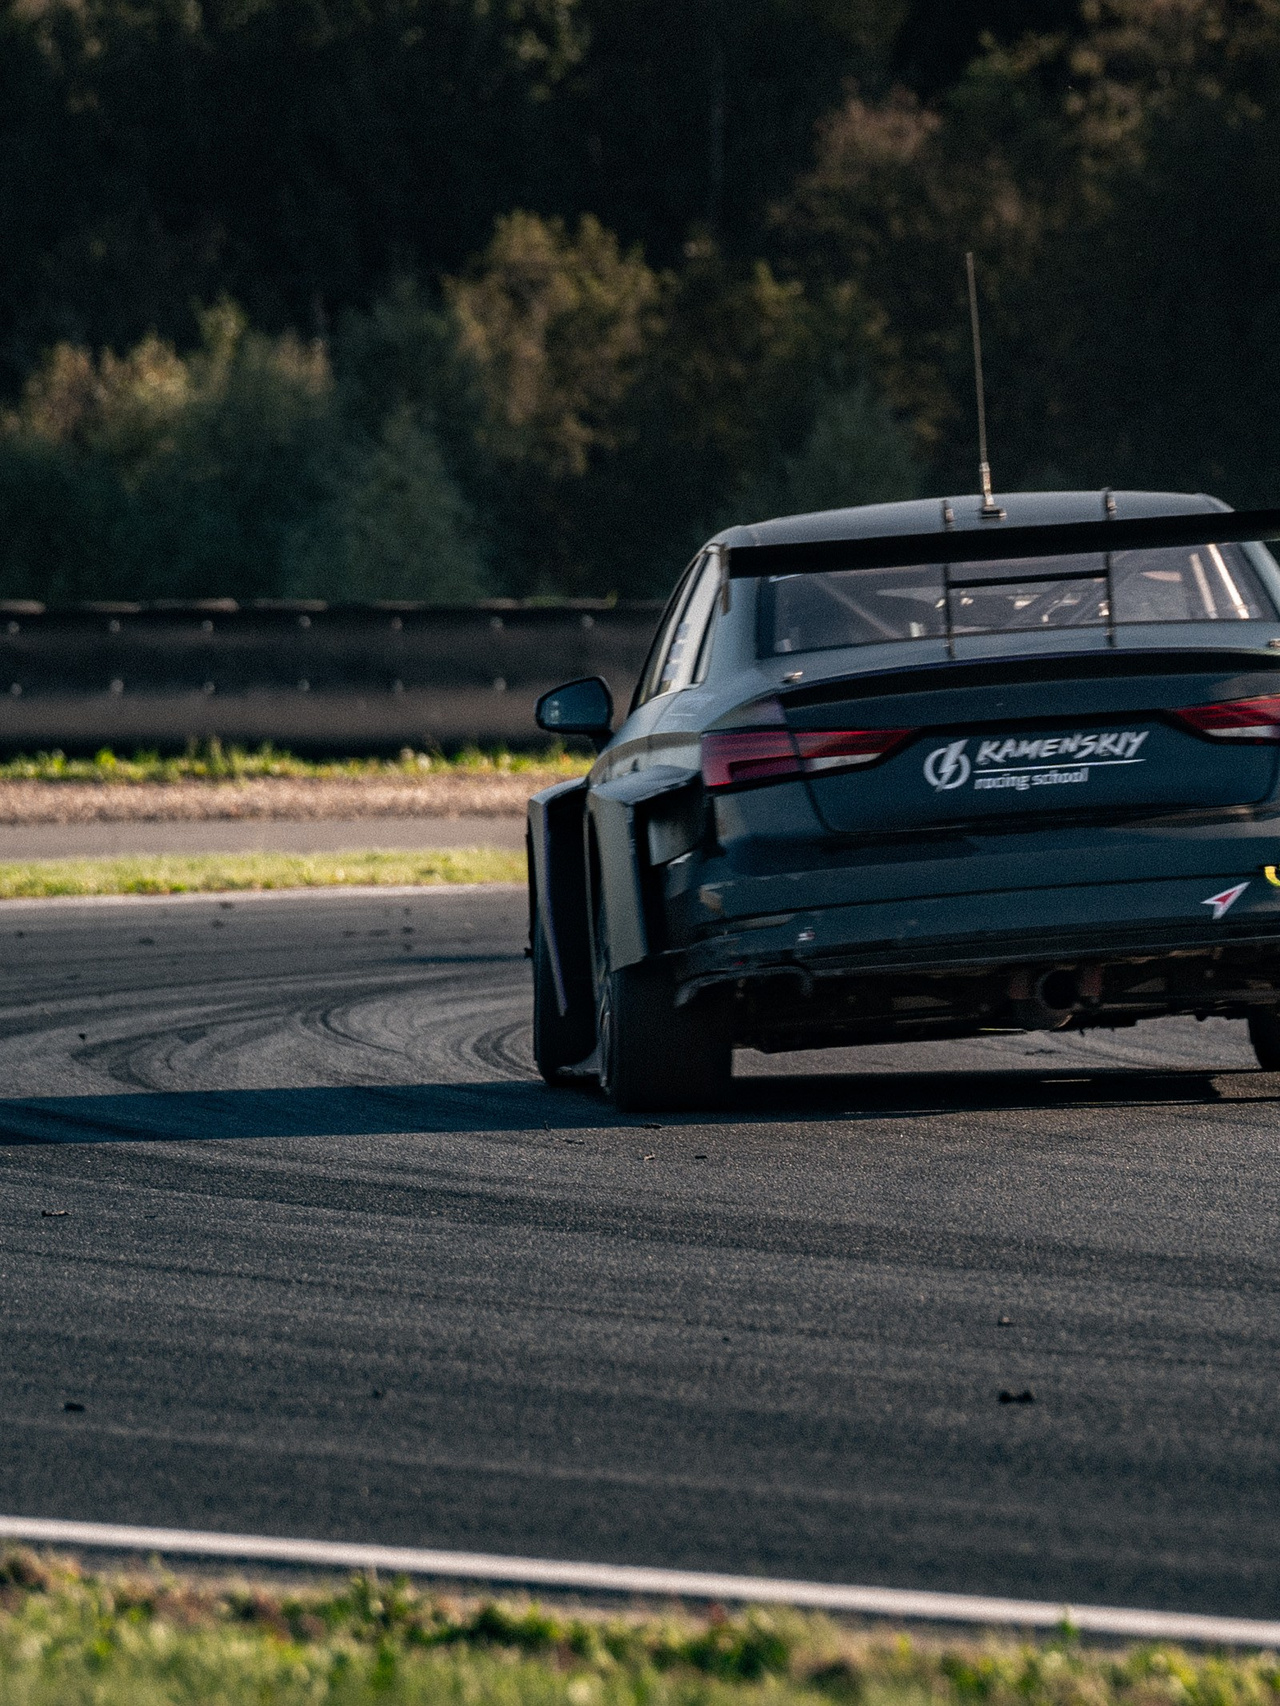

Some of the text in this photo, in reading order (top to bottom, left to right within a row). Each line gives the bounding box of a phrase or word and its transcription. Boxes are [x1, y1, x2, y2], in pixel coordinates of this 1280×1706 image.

[975, 731, 1149, 765] KAMENSKIY
[974, 767, 1089, 790] racing school
